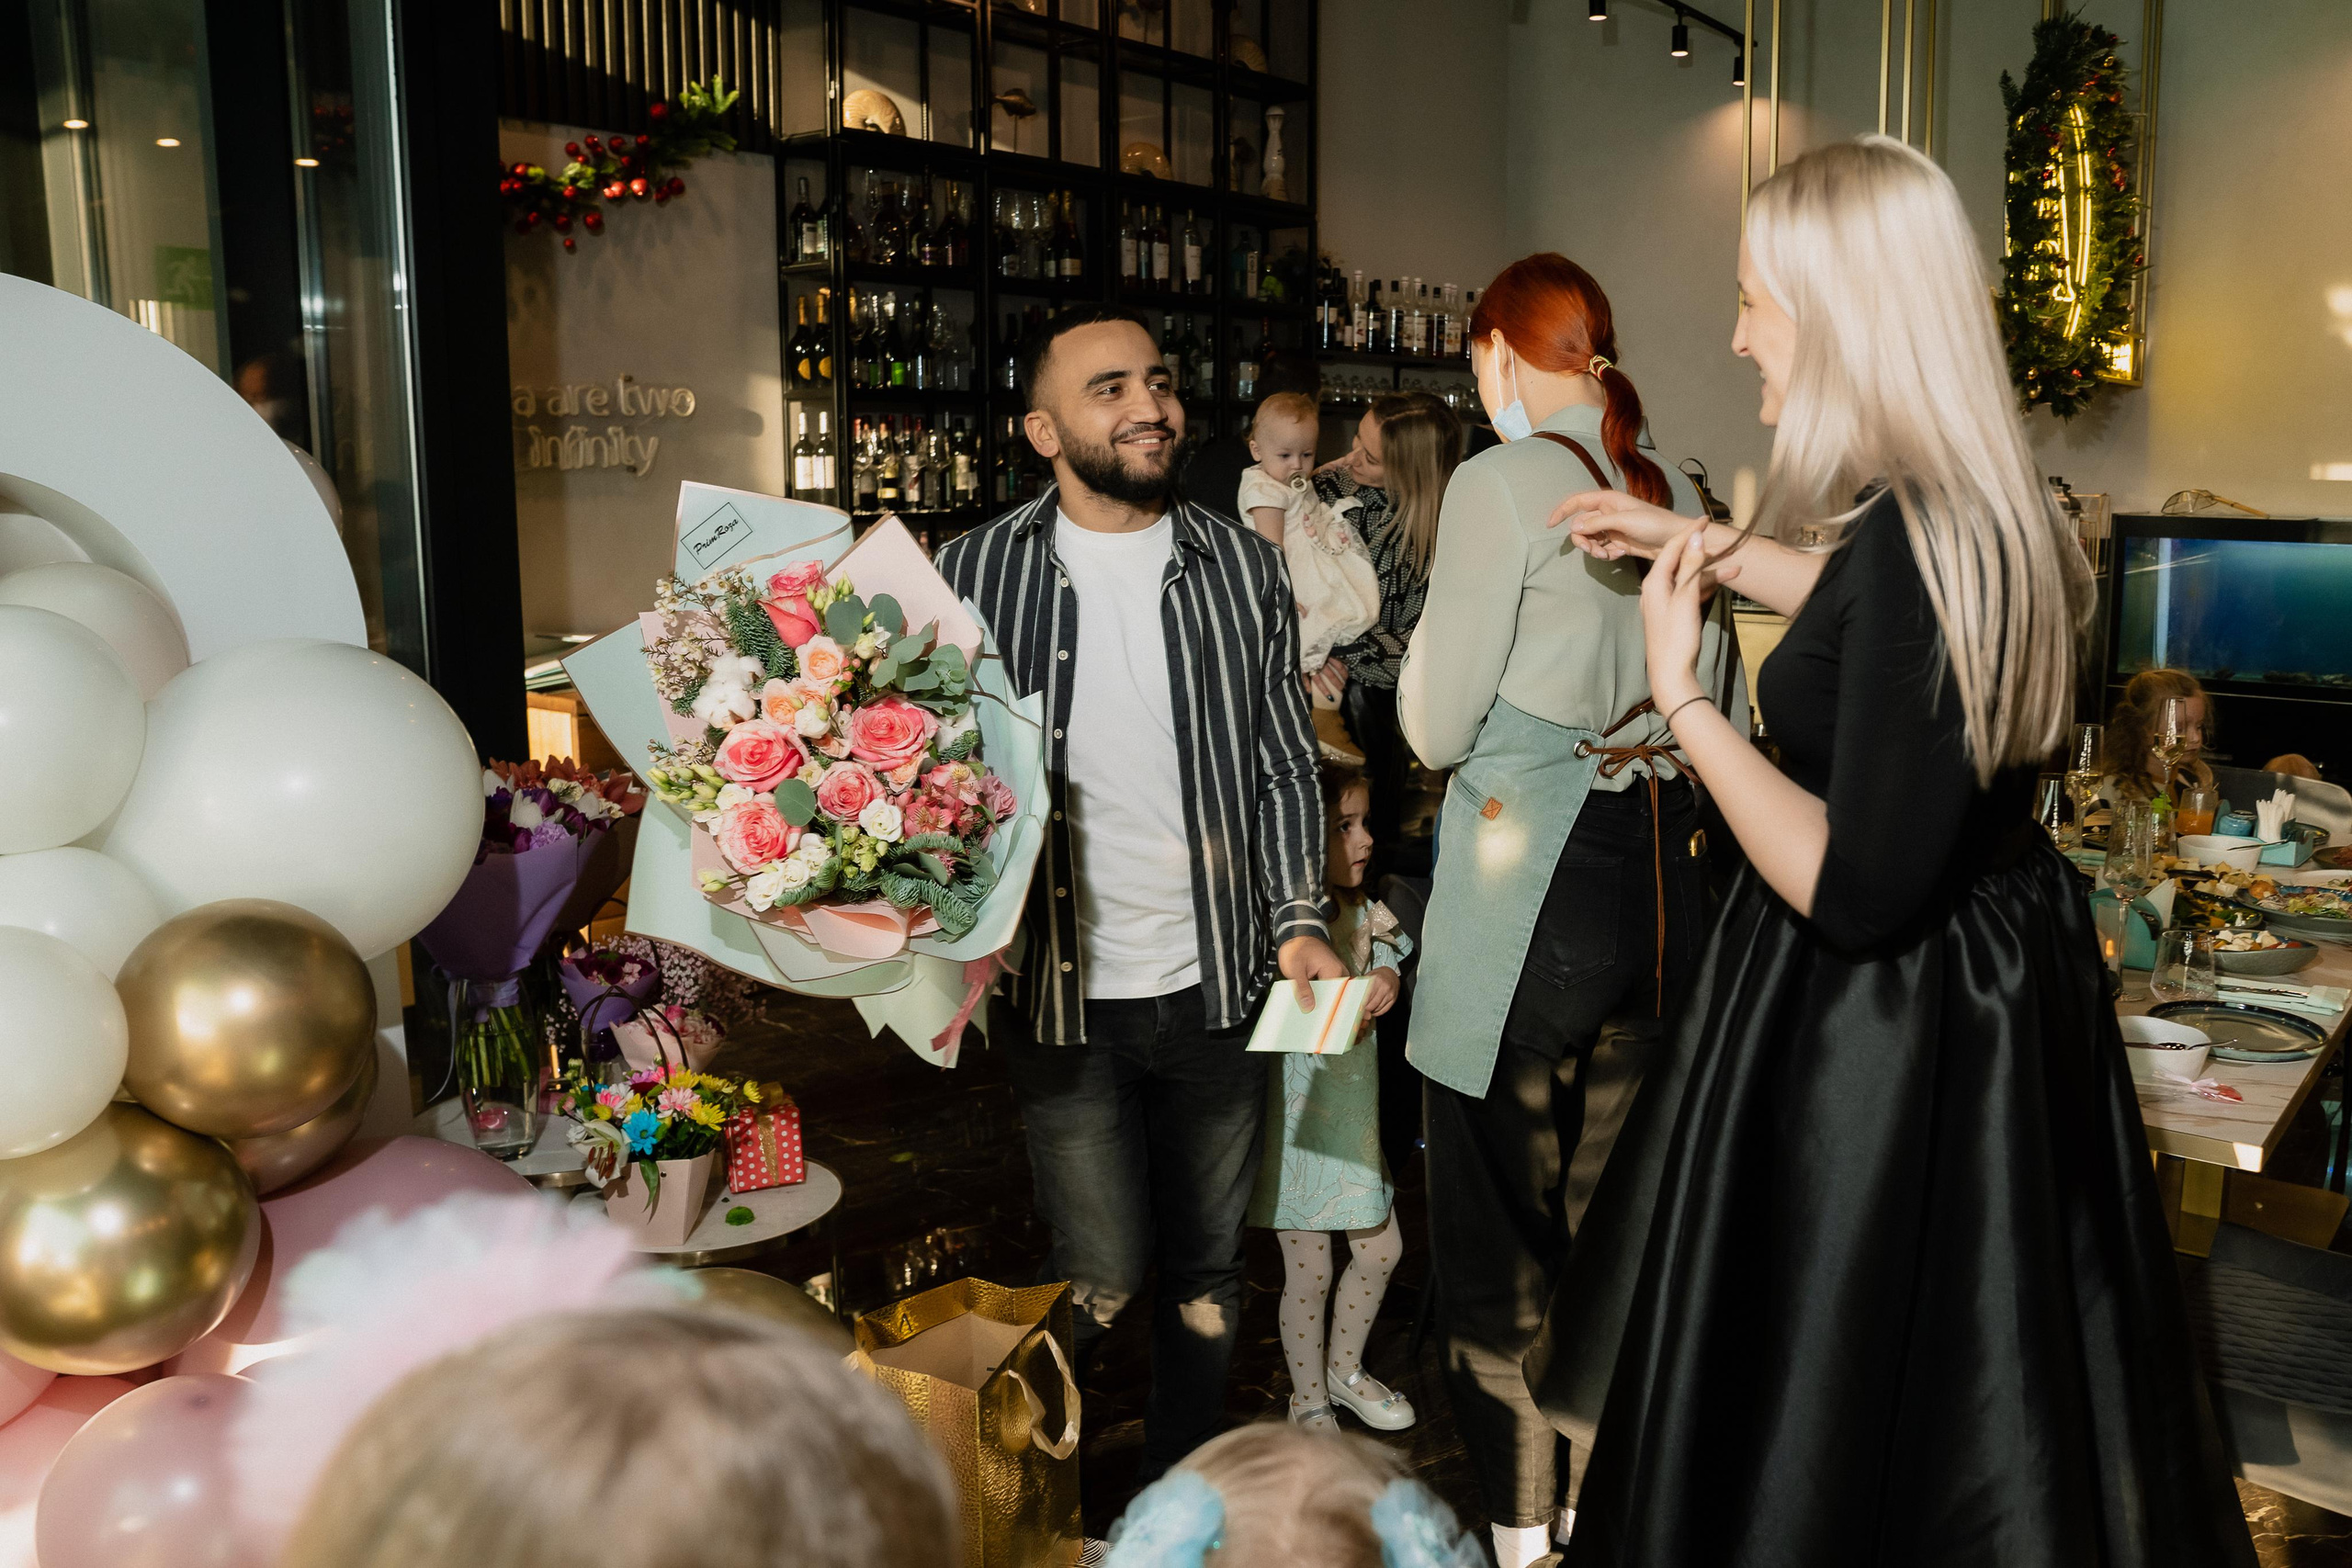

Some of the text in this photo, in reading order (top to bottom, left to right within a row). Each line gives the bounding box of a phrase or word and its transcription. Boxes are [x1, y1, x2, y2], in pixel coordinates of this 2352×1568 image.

[547, 385, 609, 416] are
[618, 373, 695, 417] two
[528, 425, 659, 477] infinity
[693, 519, 739, 555] PrimRoza
